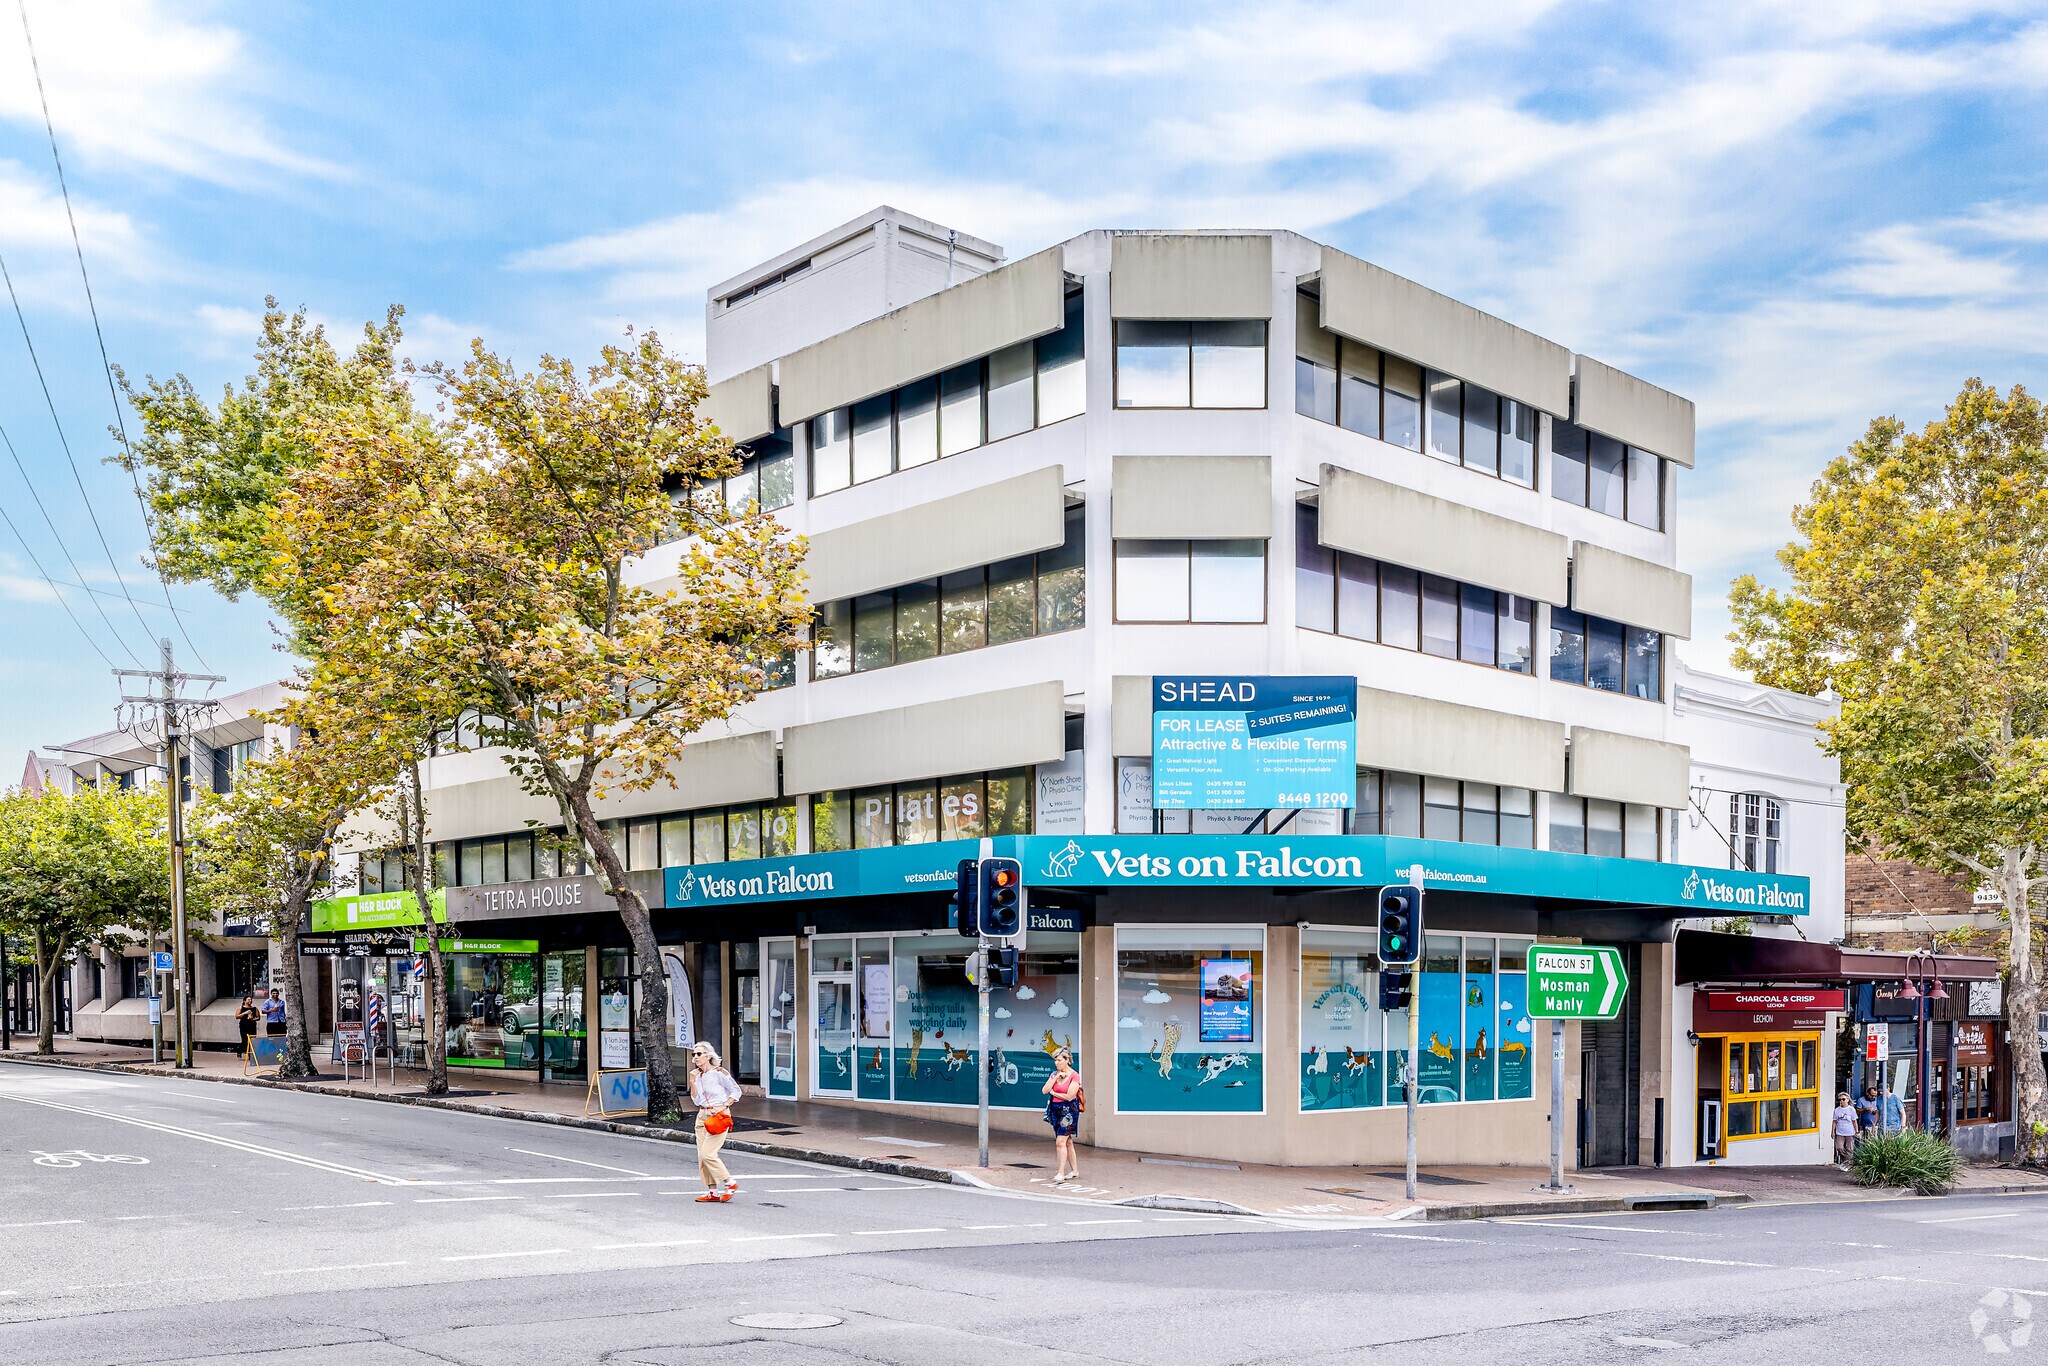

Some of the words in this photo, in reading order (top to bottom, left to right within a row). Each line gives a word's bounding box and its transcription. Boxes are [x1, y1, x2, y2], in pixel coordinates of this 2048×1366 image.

[1160, 682, 1256, 702] SHEAD
[1250, 719, 1257, 728] 2
[1258, 713, 1292, 726] SUITES
[1293, 703, 1347, 720] REMAINING!
[1160, 719, 1191, 732] FOR
[1195, 719, 1245, 732] LEASE
[1160, 737, 1227, 751] Attractive
[1231, 738, 1242, 751] &
[1247, 738, 1300, 750] Flexible
[1304, 738, 1347, 750] Terms
[1285, 766, 1306, 774] Parking
[1049, 777, 1065, 786] North
[1066, 775, 1081, 784] Shore
[1049, 786, 1066, 795] Physio
[1066, 784, 1081, 793] Clinic
[1278, 792, 1311, 804] 8448
[1315, 792, 1348, 804] 1200
[865, 792, 979, 827] Pilates
[694, 812, 788, 847] Physio
[1090, 848, 1172, 878] Vets
[1177, 856, 1228, 877] on
[1235, 846, 1364, 878] Falcon
[698, 874, 736, 899] Vets
[738, 877, 764, 896] on
[766, 865, 834, 894] Falcon
[484, 889, 527, 911] TETRA
[531, 883, 582, 908] HOUSE
[1701, 878, 1734, 902] Vets
[1735, 887, 1755, 905] on
[1757, 883, 1804, 909] Falcon
[1977, 893, 1998, 901] 9439
[360, 901, 375, 912] H&R
[376, 897, 402, 911] BLOCK
[1031, 915, 1073, 929] Falcon
[344, 933, 371, 943] SHARPS
[1538, 957, 1576, 969] FALCON
[1580, 959, 1591, 969] ST
[512, 987, 531, 995] BLOCK
[1540, 978, 1589, 992] Mosman
[1312, 991, 1331, 1009] Vets
[1330, 984, 1342, 995] on
[1344, 982, 1369, 1012] Falcon
[1735, 995, 1781, 1003] CHARCOAL
[1782, 995, 1789, 1003] &
[1790, 995, 1815, 1003] CRISP
[911, 1003, 945, 1018] keeping
[947, 1002, 965, 1013] tails
[1545, 996, 1584, 1014] Manly
[908, 1019, 945, 1032] wagging
[946, 1016, 967, 1030] daily
[1753, 1014, 1773, 1023] LECHON
